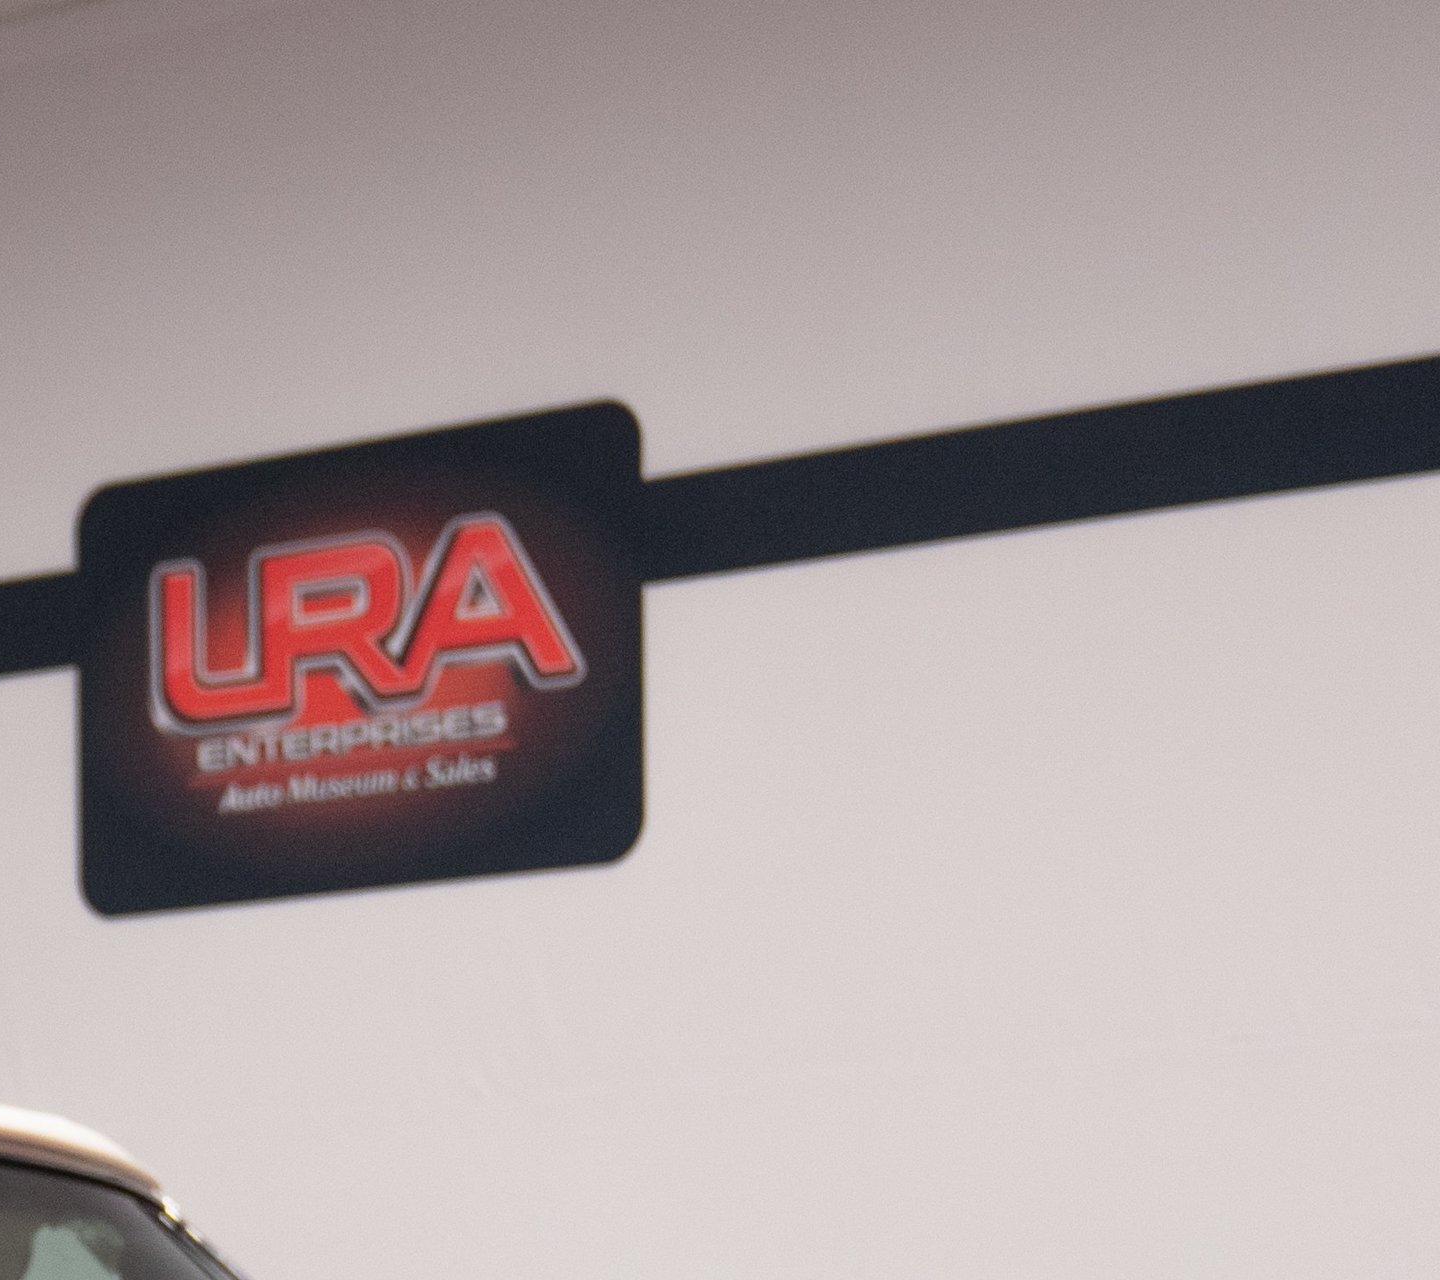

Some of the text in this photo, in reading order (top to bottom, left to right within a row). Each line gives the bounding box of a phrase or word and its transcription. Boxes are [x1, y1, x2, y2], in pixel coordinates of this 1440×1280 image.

[150, 510, 588, 735] URA
[196, 701, 507, 772] ENTERPRISES
[218, 783, 284, 814] Auto
[287, 770, 399, 803] Museum
[424, 756, 497, 788] Sales
